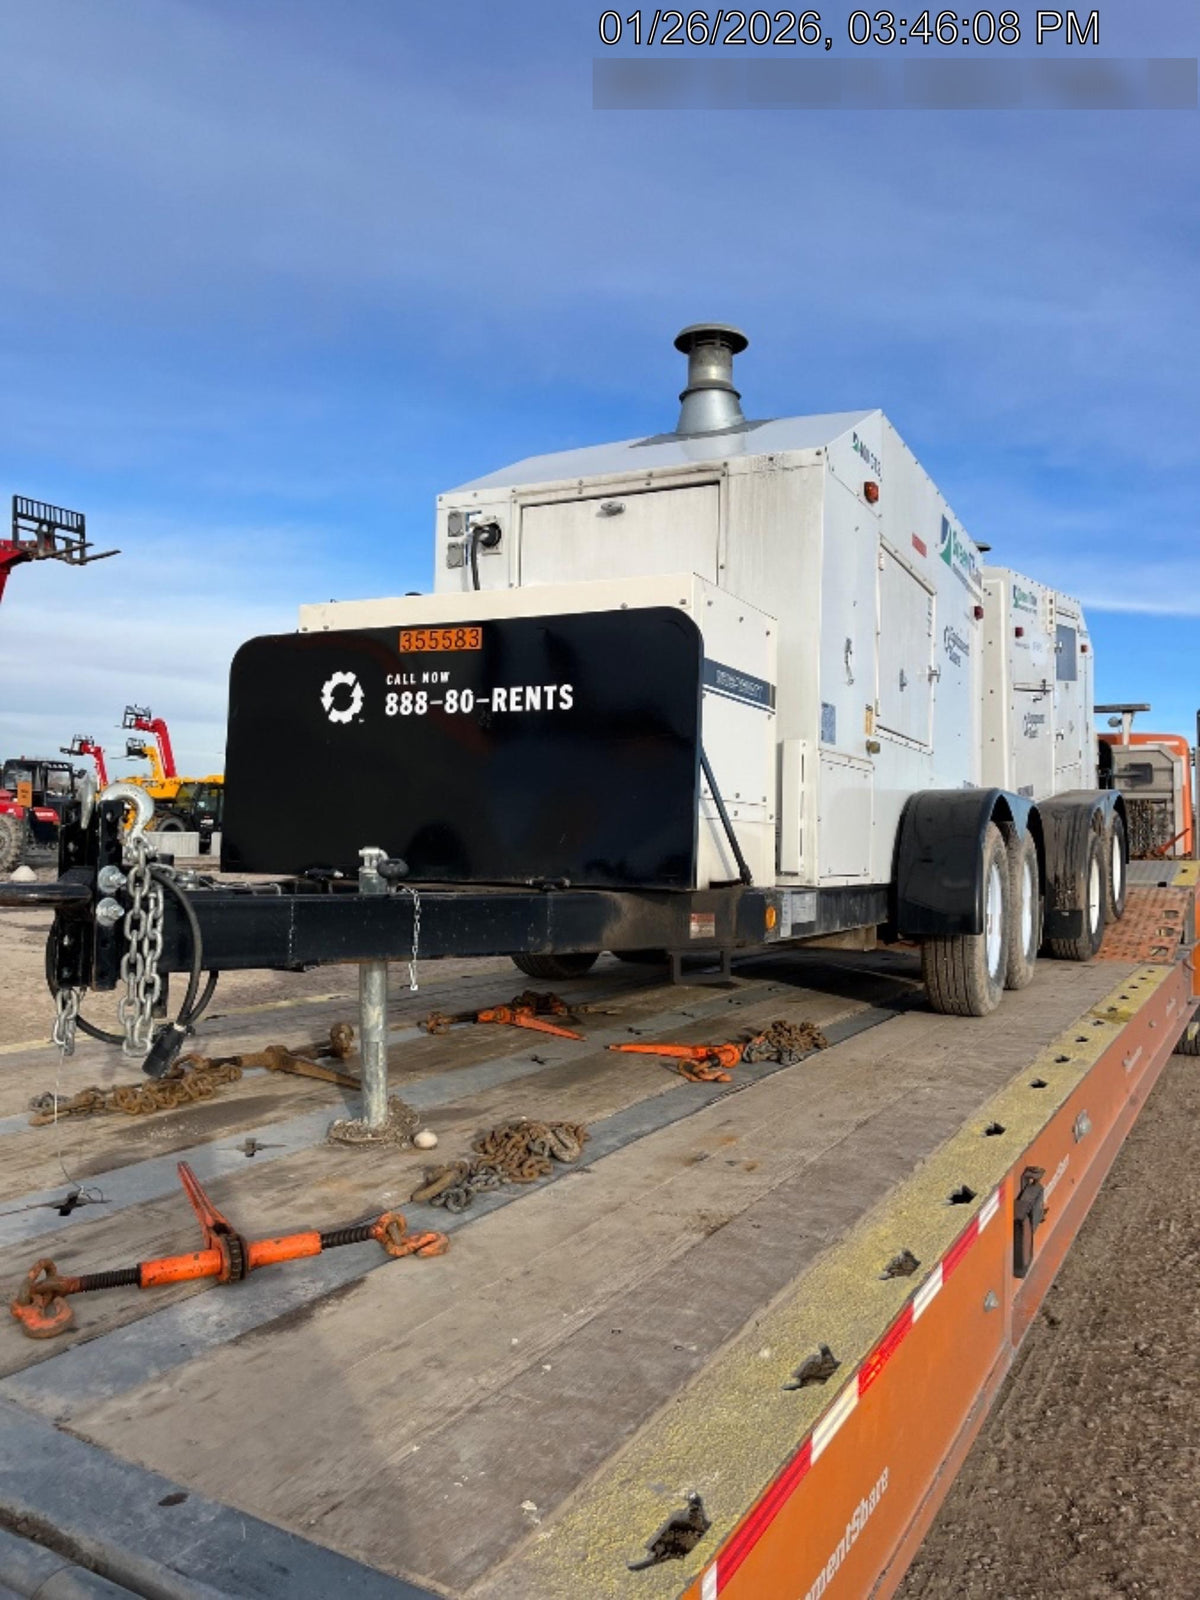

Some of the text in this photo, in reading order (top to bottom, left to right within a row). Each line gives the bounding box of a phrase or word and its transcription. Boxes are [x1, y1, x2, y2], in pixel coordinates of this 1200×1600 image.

[401, 628, 480, 651] 355583
[386, 671, 450, 685] CALL NOW
[385, 684, 574, 716] 888-80-RENTS
